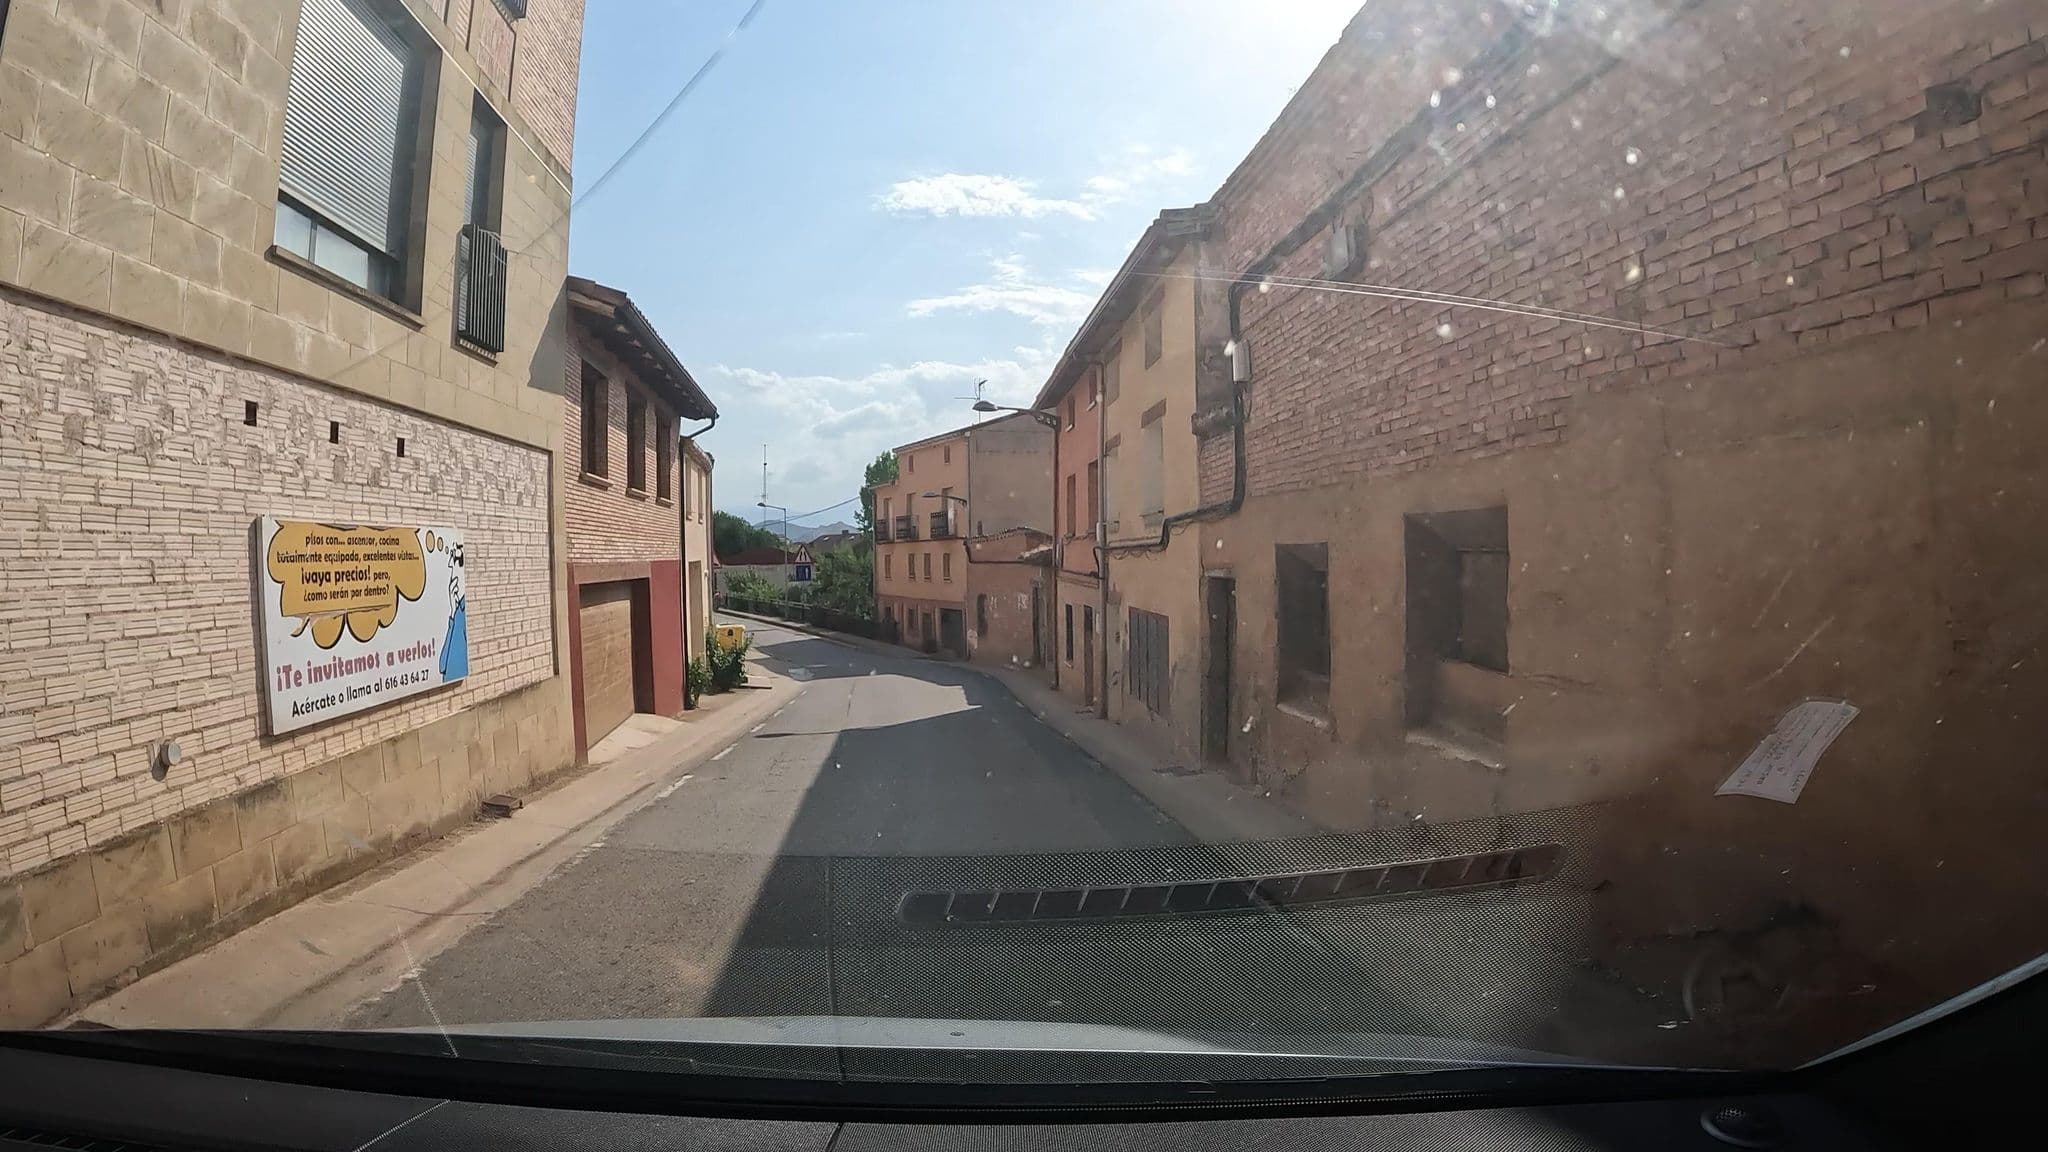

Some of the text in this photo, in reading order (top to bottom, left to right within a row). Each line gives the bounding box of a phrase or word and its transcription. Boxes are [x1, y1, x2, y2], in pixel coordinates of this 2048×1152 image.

[305, 533, 324, 547] pisos
[379, 536, 400, 545] cocina
[363, 551, 396, 561] excelentes
[334, 565, 371, 585] precios!
[373, 571, 391, 581] pero,
[330, 587, 349, 599] serán
[351, 589, 362, 600] por
[363, 584, 389, 597] dentro?
[276, 637, 435, 692] ¡Te invitamos a verlos!
[291, 669, 429, 718] Acércate o llama al 616 43 64 27
